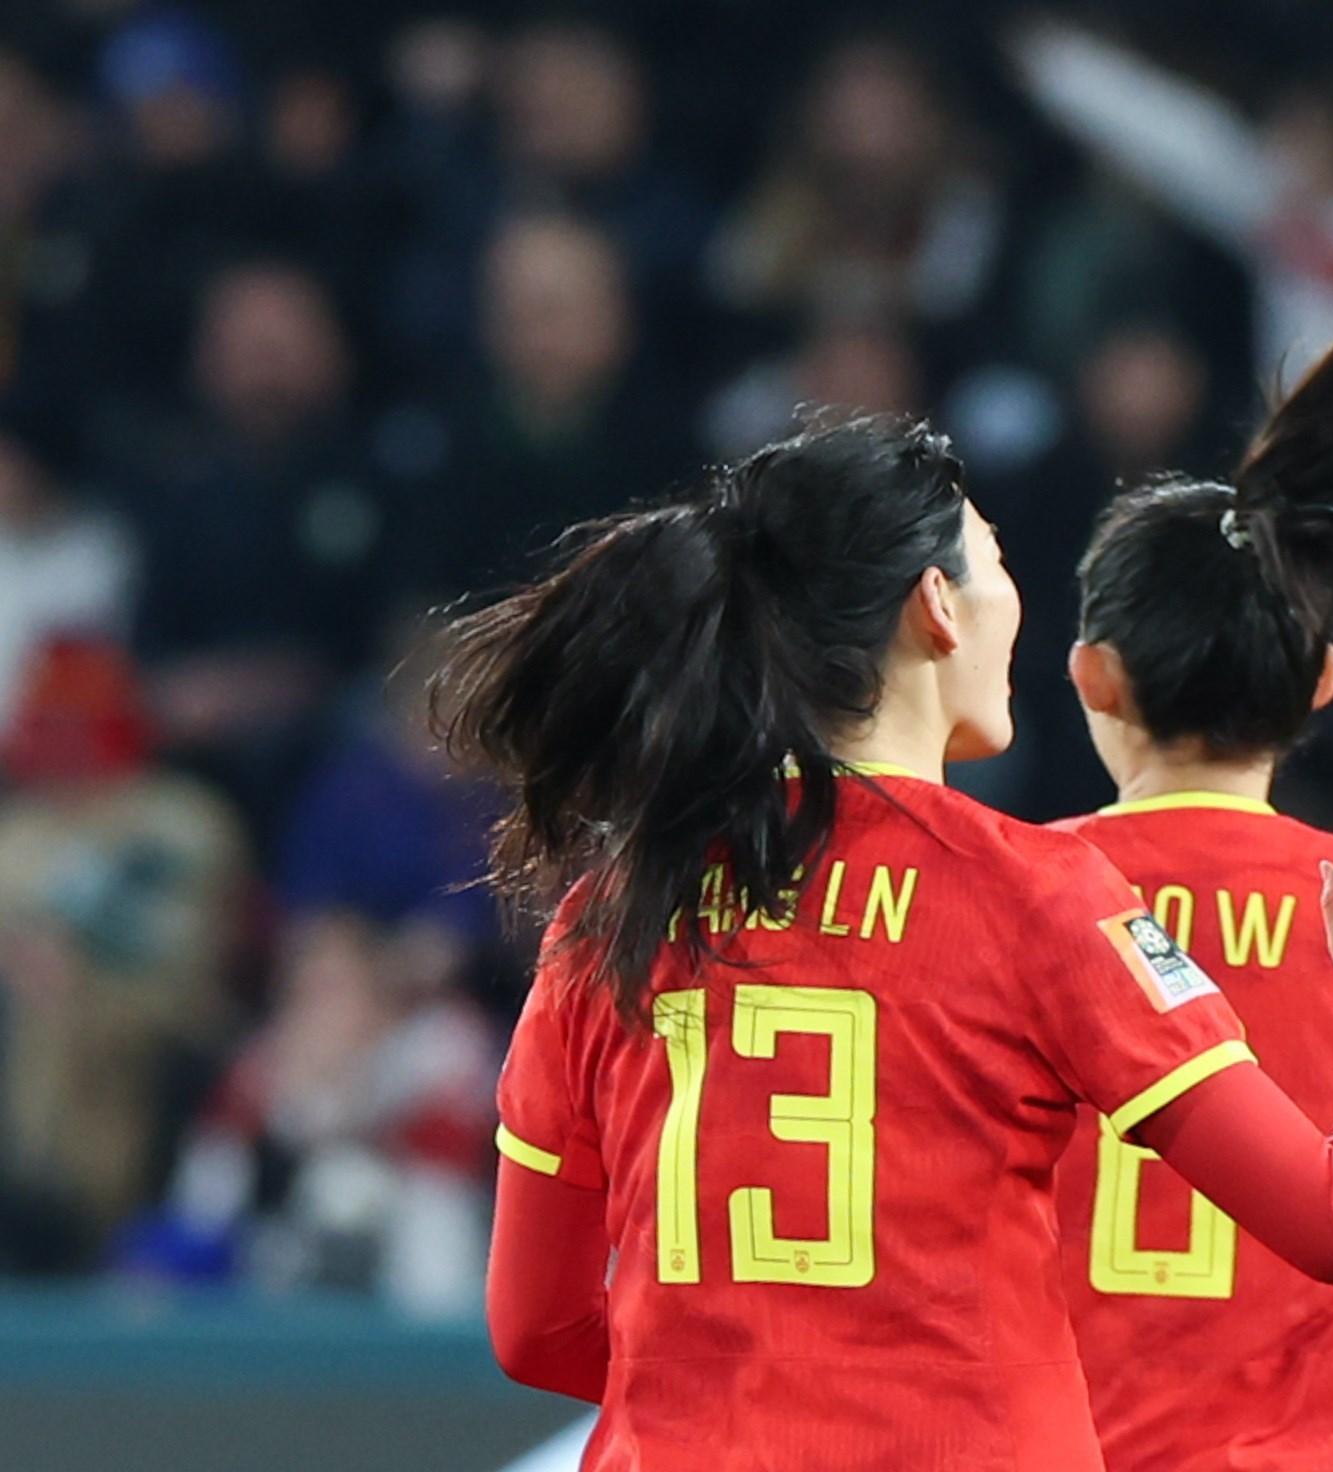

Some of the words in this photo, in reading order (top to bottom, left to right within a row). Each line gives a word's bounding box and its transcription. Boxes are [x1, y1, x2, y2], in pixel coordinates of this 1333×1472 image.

[820, 860, 918, 943] LN
[1215, 888, 1297, 969] W
[652, 983, 877, 1288] 13
